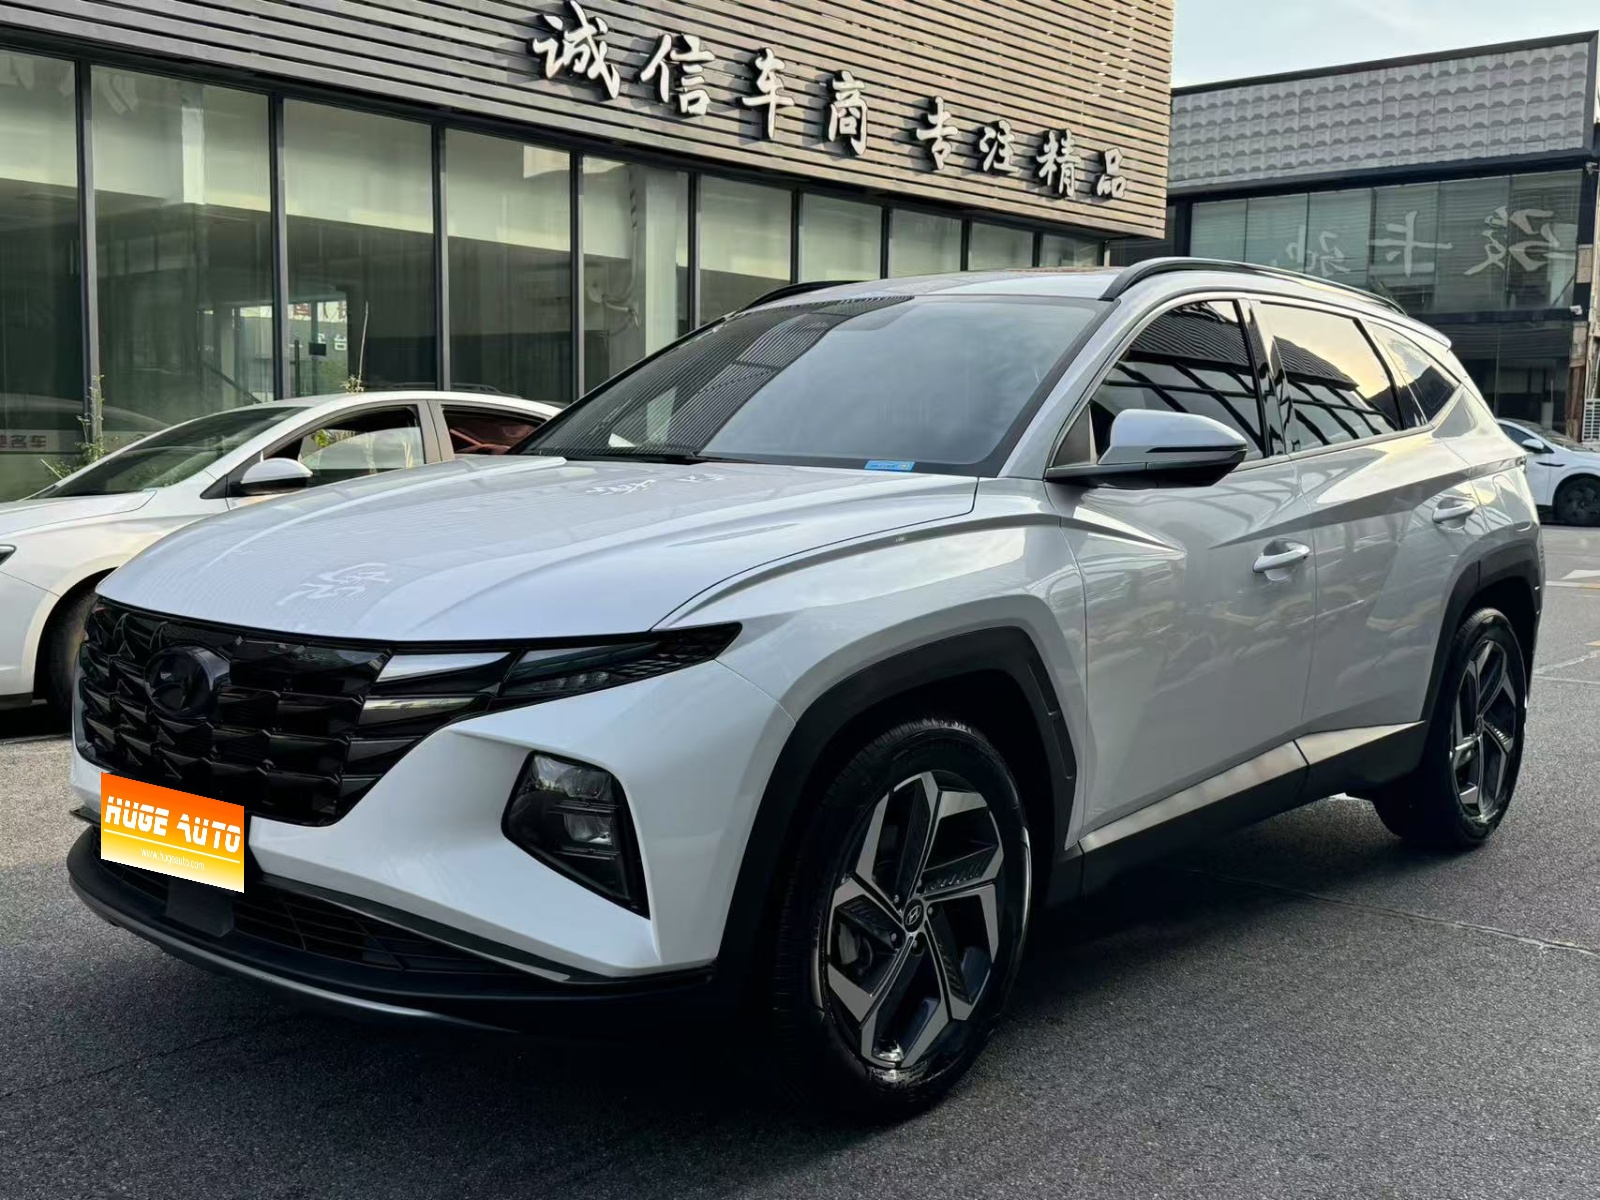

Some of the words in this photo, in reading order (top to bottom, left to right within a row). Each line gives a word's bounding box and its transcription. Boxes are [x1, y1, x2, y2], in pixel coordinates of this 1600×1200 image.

[532, 1, 867, 156] 诚信车商
[914, 98, 1128, 198] 专注精品
